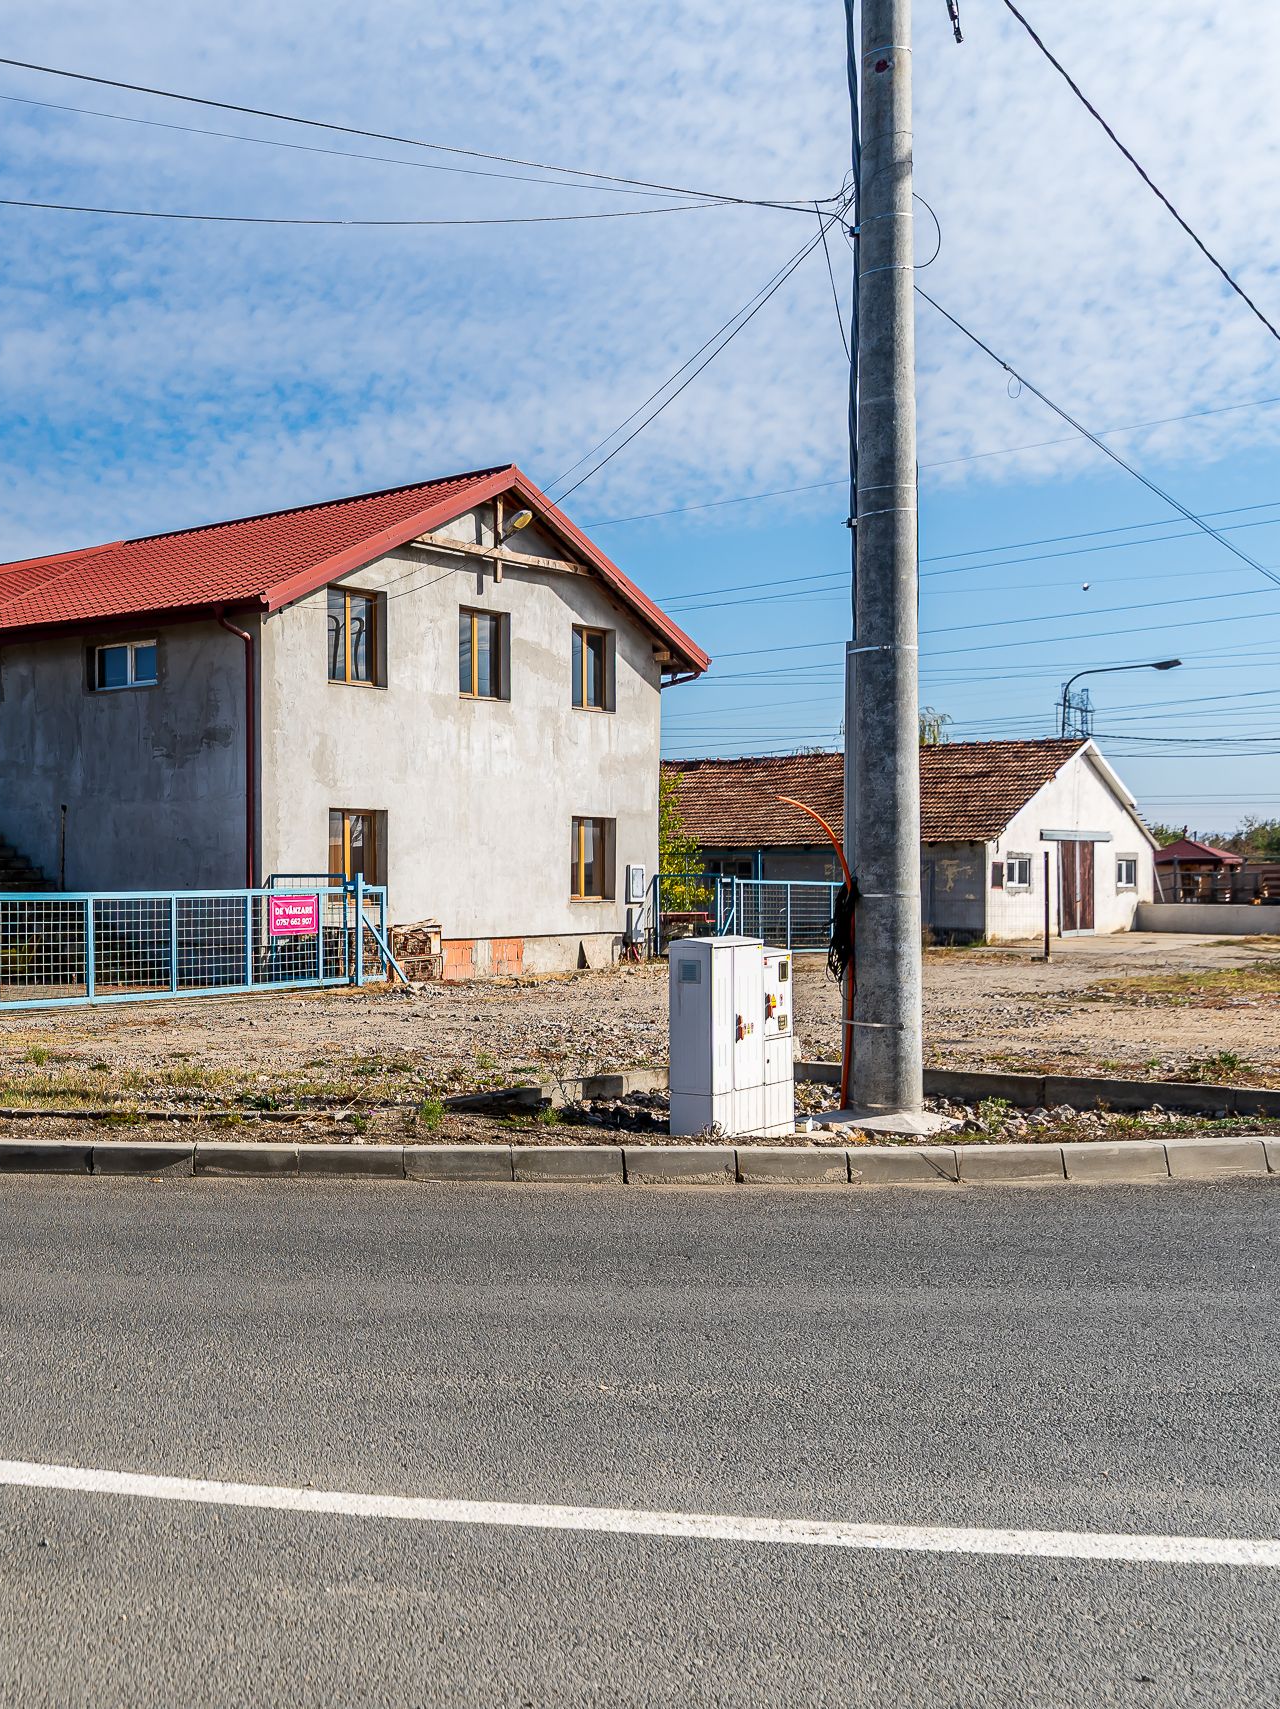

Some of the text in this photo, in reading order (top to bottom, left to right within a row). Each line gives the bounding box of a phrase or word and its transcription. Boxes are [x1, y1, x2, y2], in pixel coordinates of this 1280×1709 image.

[275, 907, 283, 915] DE
[276, 917, 312, 926] 0757 662 907
